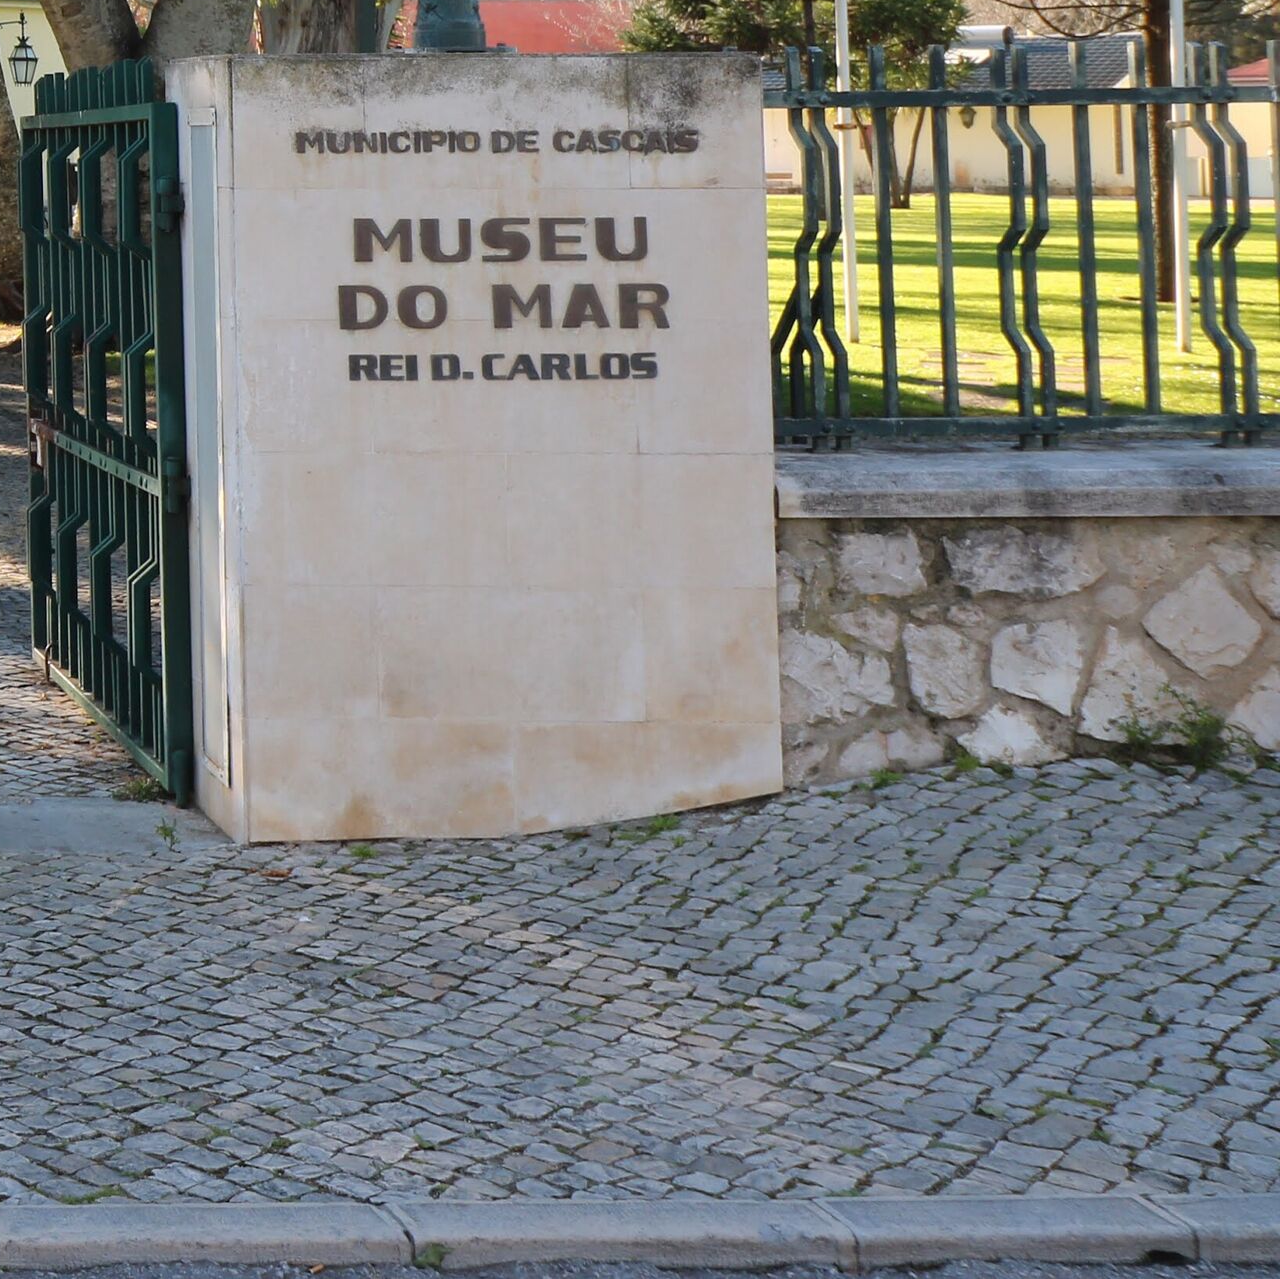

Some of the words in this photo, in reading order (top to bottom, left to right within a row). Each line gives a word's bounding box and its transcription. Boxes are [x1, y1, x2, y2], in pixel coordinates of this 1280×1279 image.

[295, 130, 481, 155] MUNICIPIO
[491, 130, 540, 154] DE
[552, 129, 700, 155] CASCAIS
[352, 216, 649, 262] MUSEU
[337, 284, 449, 330] DO
[491, 282, 671, 330] MAR
[348, 354, 419, 381] REI
[431, 353, 474, 381] D.
[481, 352, 659, 381] CARLOS
